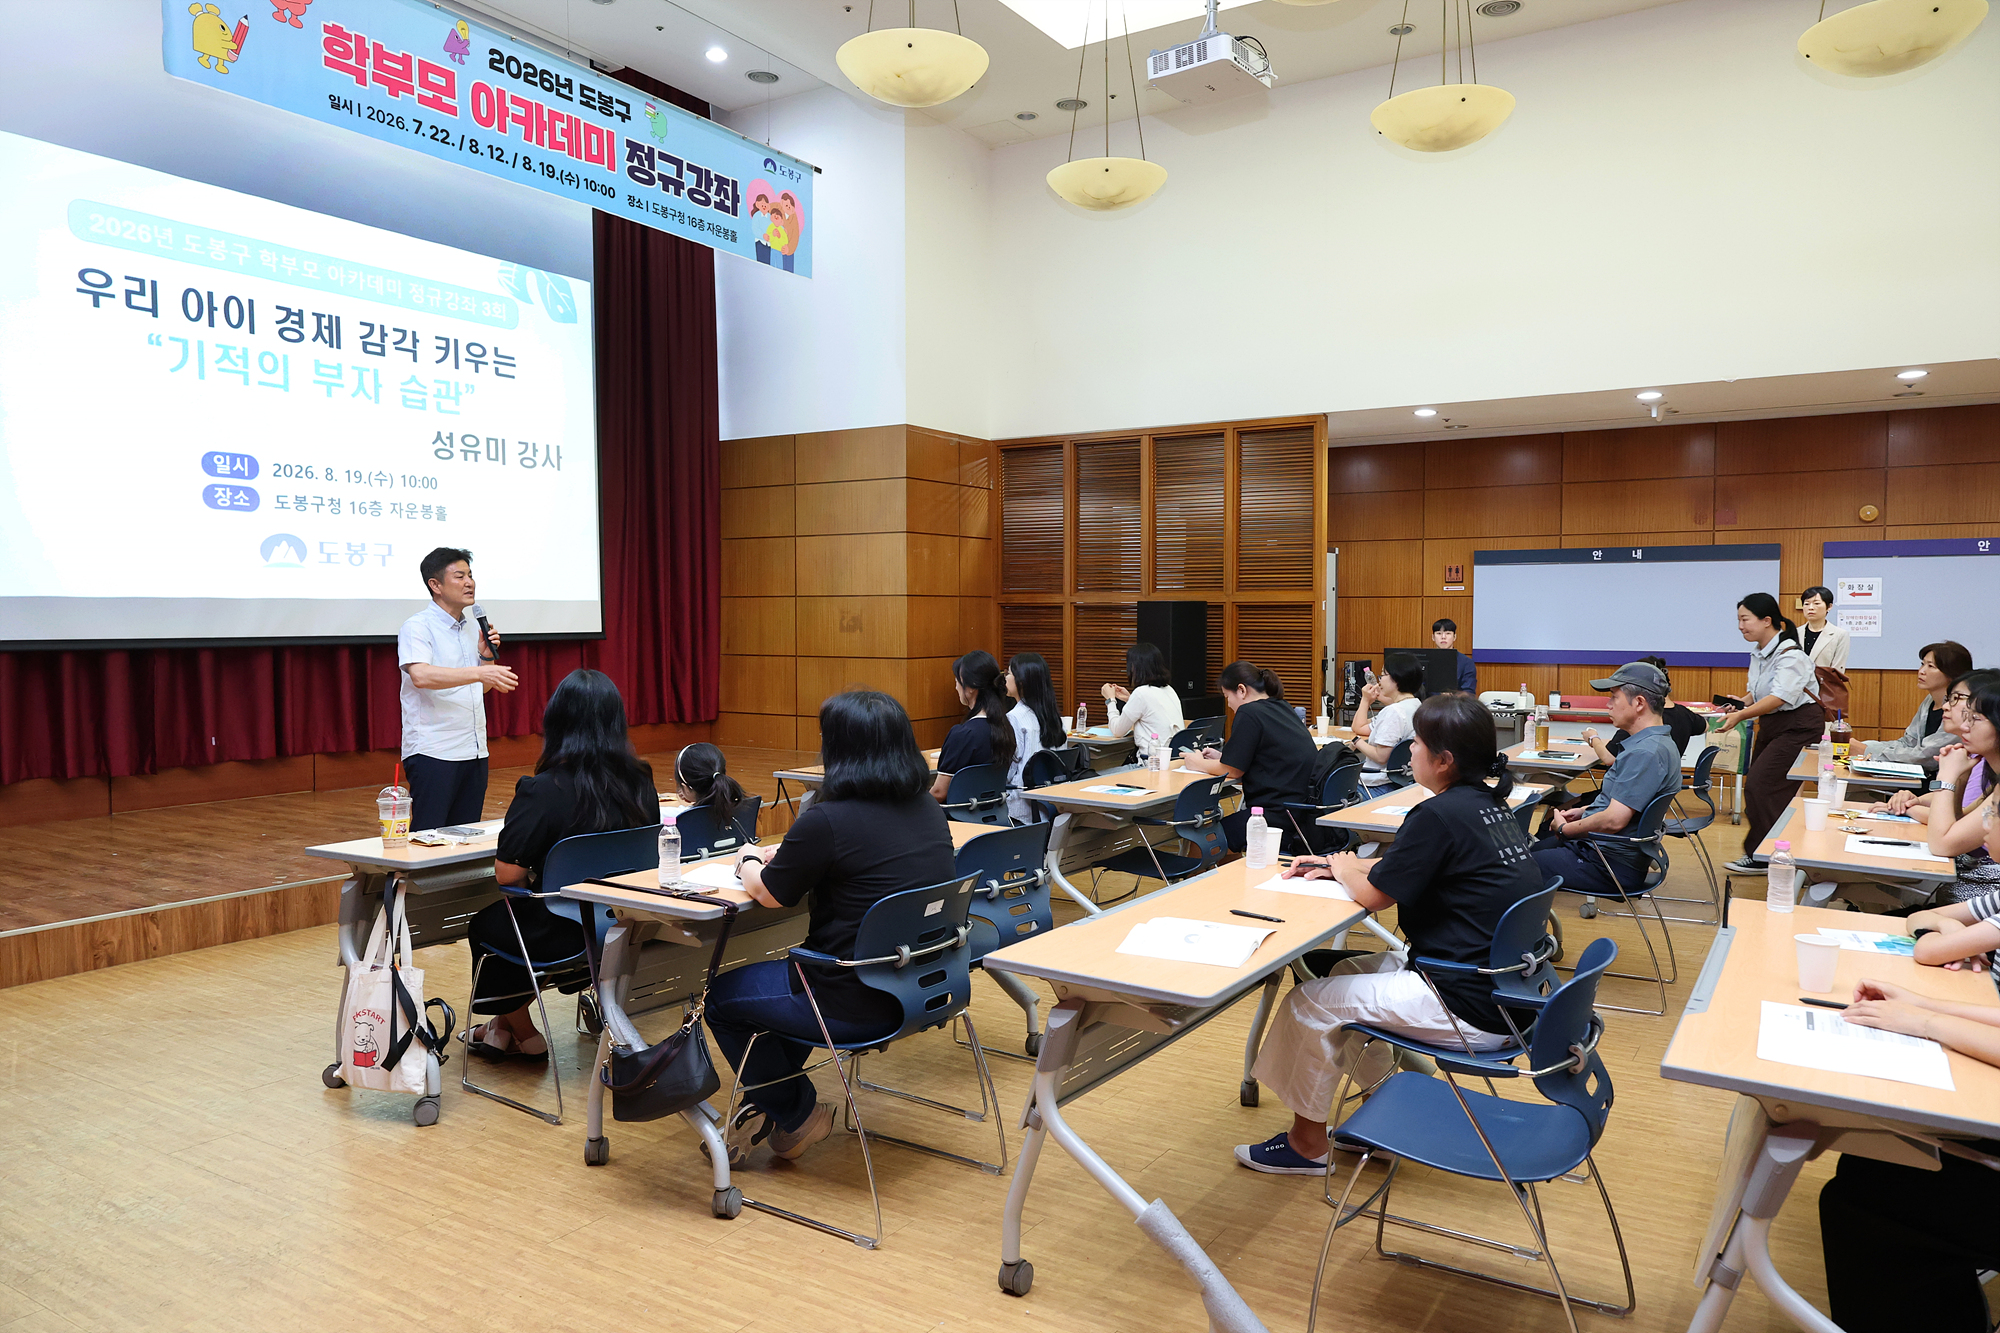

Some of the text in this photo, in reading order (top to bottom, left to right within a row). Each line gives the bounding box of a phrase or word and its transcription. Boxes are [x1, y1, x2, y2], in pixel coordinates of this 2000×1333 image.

[488, 48, 632, 123] 2026년 도봉구
[322, 22, 741, 218] 학부모 아카데미 정규강좌
[328, 94, 353, 115] 일시
[366, 106, 409, 132] 2026.
[583, 178, 616, 198] 10:00
[779, 165, 802, 184] 도봉구
[627, 194, 644, 210] 장소
[652, 203, 685, 225] 도봉구청
[687, 215, 705, 232] 16층
[706, 222, 738, 244] 자운봉홀
[88, 212, 507, 321] 2026년 도봉구 학부모 아카데미 정규강좌 3회
[76, 267, 517, 380] 우리 아이 경제 감각 키우는
[147, 333, 476, 416] “기적의 부자 습관”
[212, 454, 249, 477] 일시
[272, 463, 319, 480] 2026.
[324, 467, 338, 482] 8.
[400, 474, 438, 490] 10:00
[431, 430, 563, 472] 성유미 강사
[213, 486, 448, 522] 장소 도봉구청 16층 자운봉홀
[318, 540, 395, 568] 도봉구
[1977, 540, 1991, 552] 안
